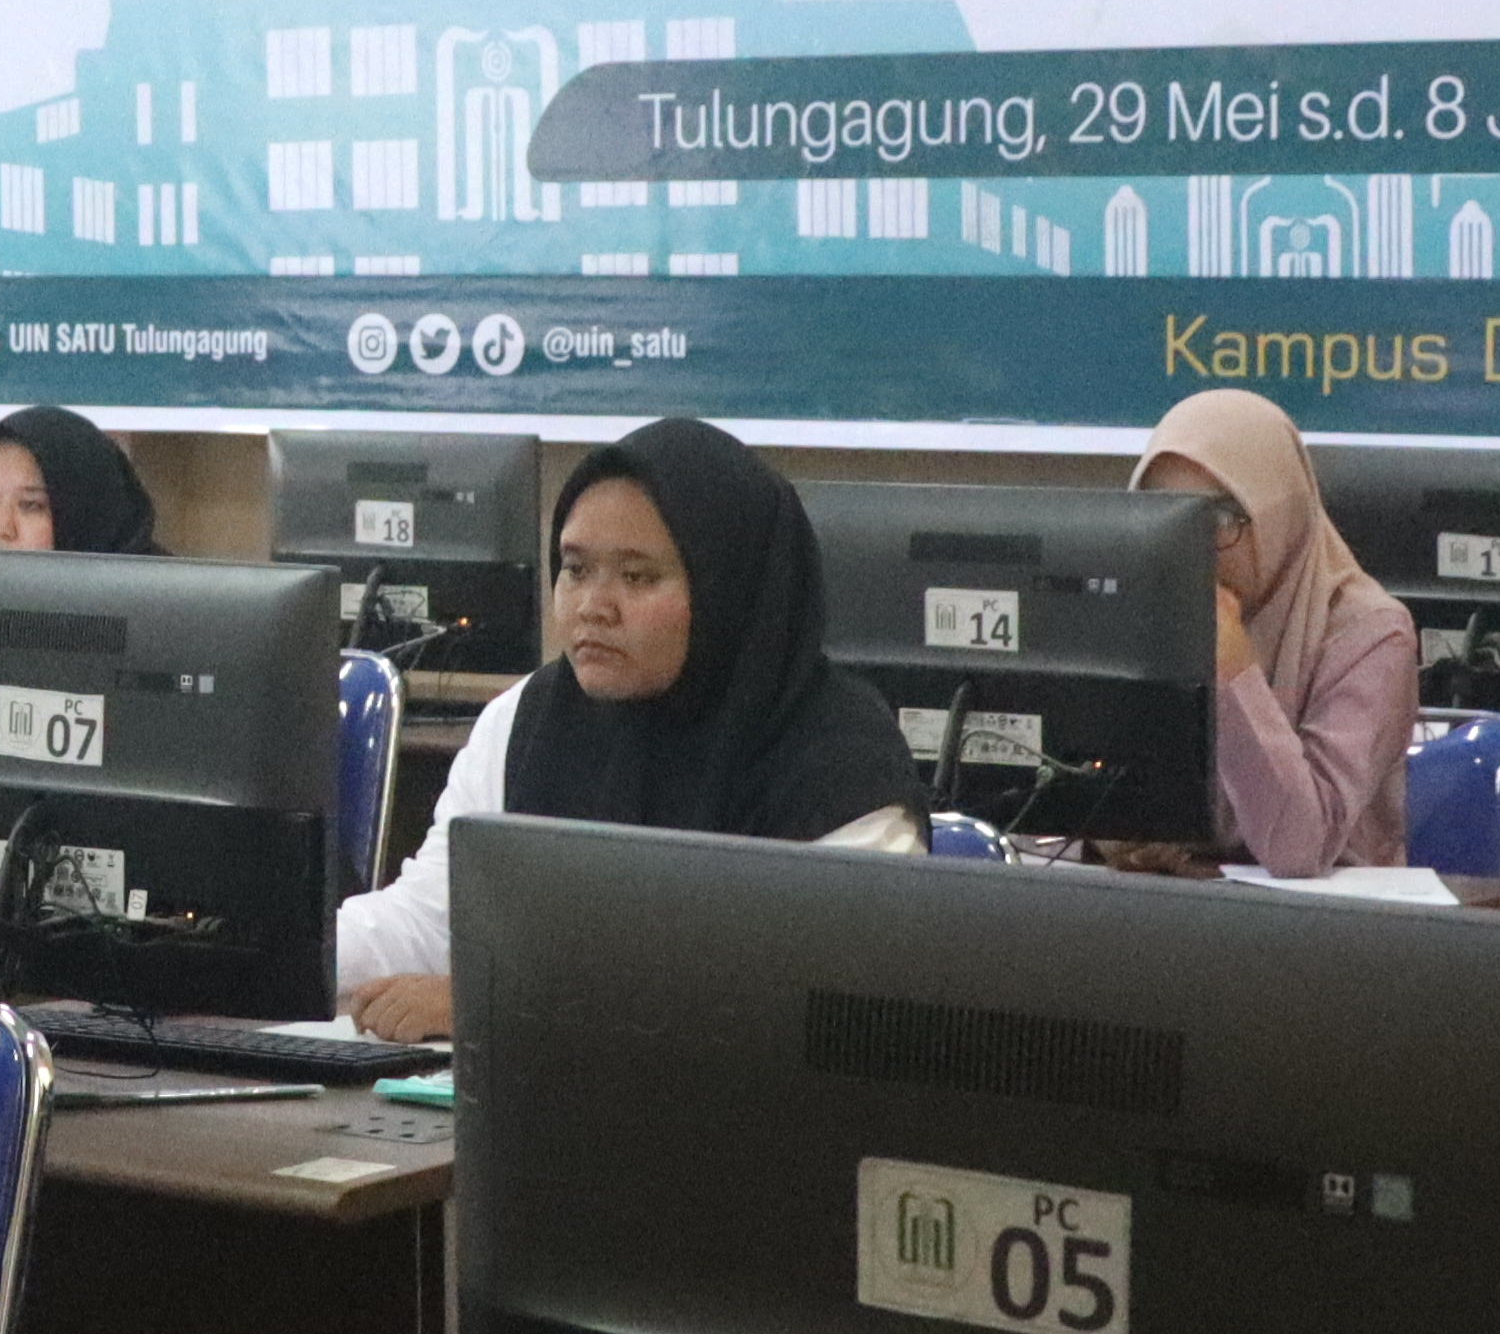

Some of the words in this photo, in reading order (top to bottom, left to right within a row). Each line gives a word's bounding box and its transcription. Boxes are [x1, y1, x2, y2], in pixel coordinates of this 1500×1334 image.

[638, 89, 1045, 163] Tulungagung,
[1068, 82, 1147, 144] 29
[1168, 80, 1280, 142] Mei
[1298, 74, 1405, 142] s.d.
[1426, 75, 1467, 140] 8
[9, 324, 50, 352] UIN
[56, 324, 116, 353] SATU
[123, 325, 267, 361] Tulungagung
[542, 328, 687, 366] @uin_satu
[1165, 314, 1449, 395] Kampus
[383, 518, 409, 542] 18
[983, 600, 998, 612] PC
[970, 612, 1012, 647] 14
[65, 699, 83, 715] PC
[47, 714, 97, 760] 07
[1034, 1194, 1080, 1231] PC
[991, 1226, 1115, 1332] 05
